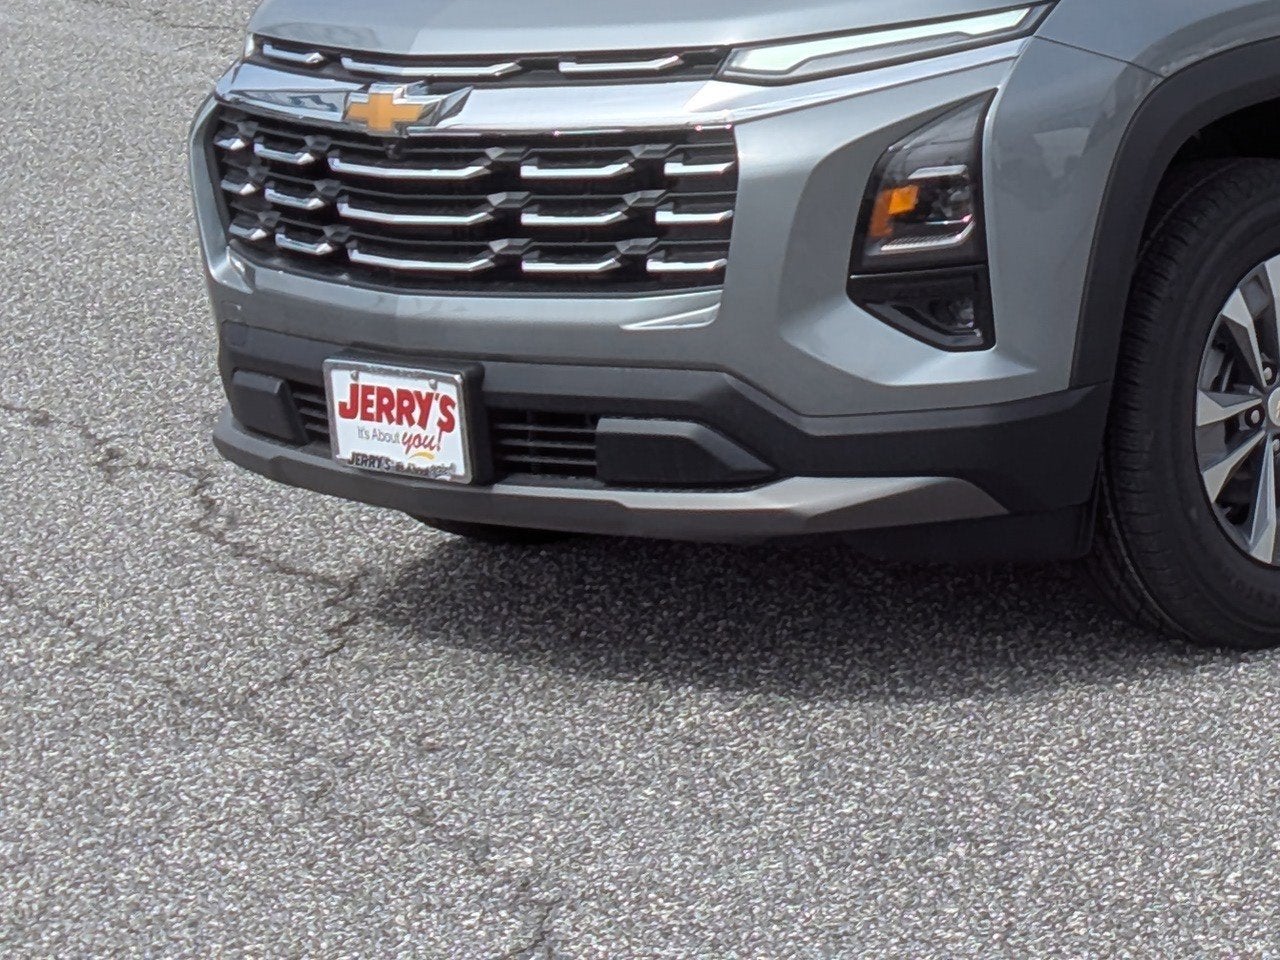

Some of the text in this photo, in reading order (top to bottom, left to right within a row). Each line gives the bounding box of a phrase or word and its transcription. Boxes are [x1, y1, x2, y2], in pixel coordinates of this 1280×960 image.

[338, 383, 456, 433] JERRY'S
[357, 425, 443, 455] It's About you!
[348, 451, 395, 471] JERRY'S
